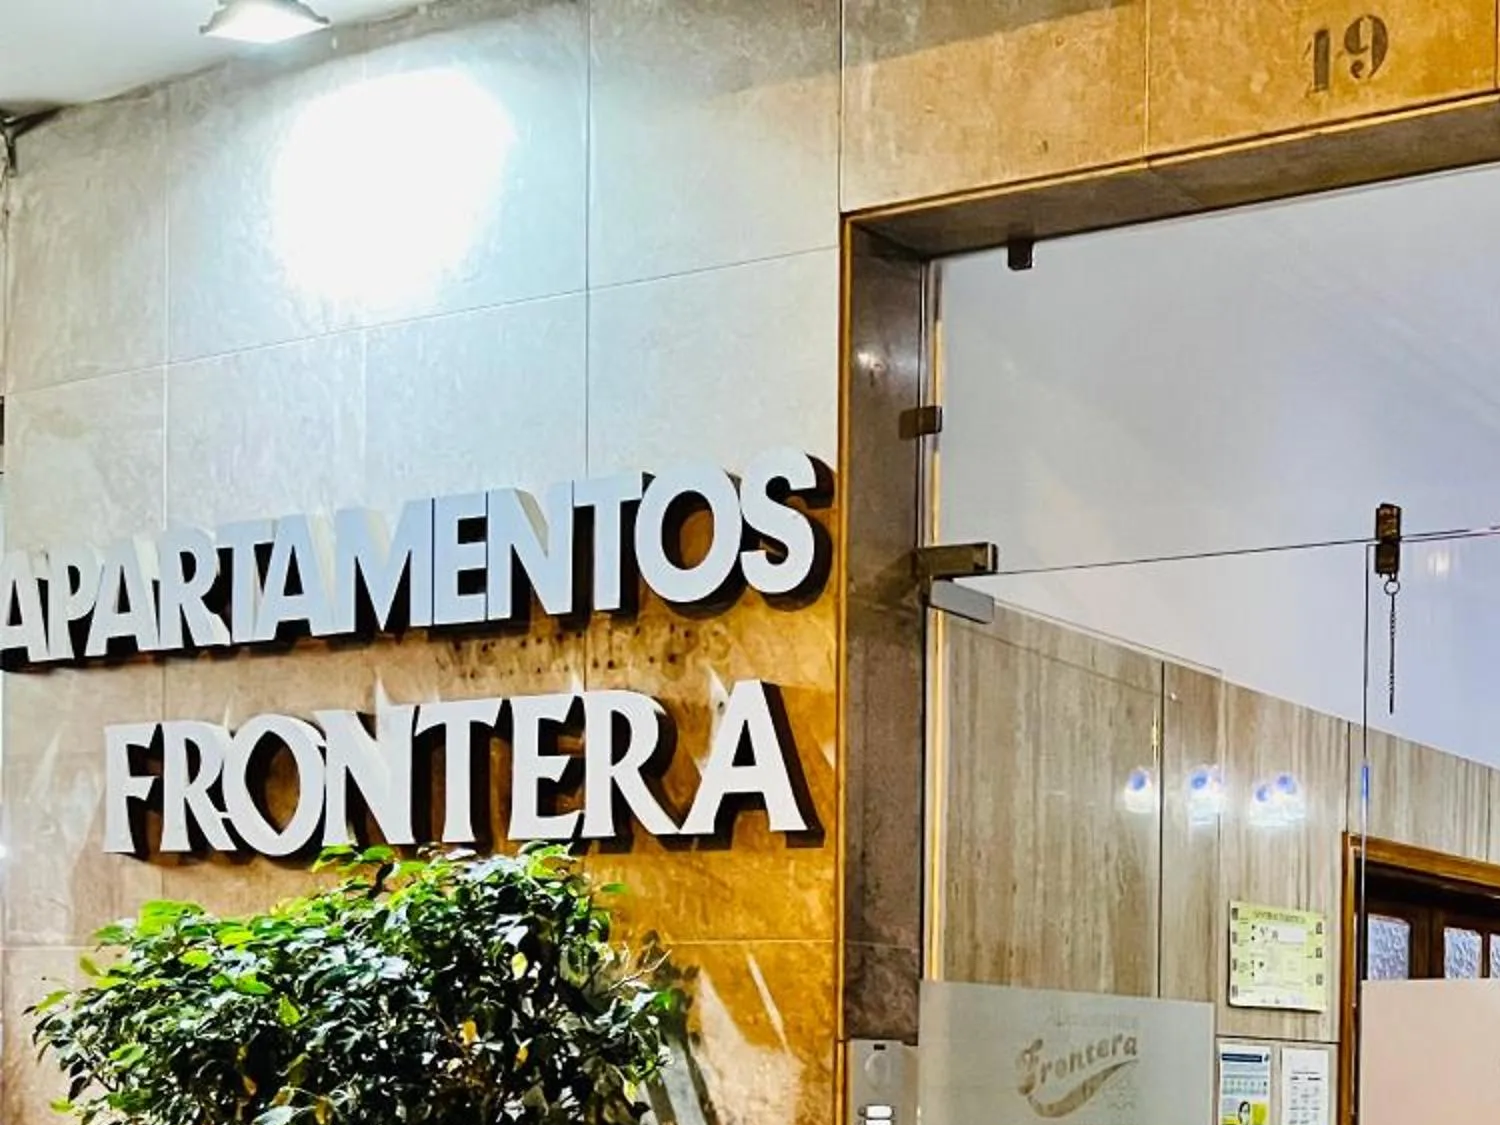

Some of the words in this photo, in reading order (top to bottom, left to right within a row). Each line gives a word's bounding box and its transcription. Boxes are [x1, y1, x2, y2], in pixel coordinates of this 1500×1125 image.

[1303, 14, 1389, 98] 19
[0, 448, 830, 666] APARTAMENTOS
[104, 679, 815, 859] FRONTERA
